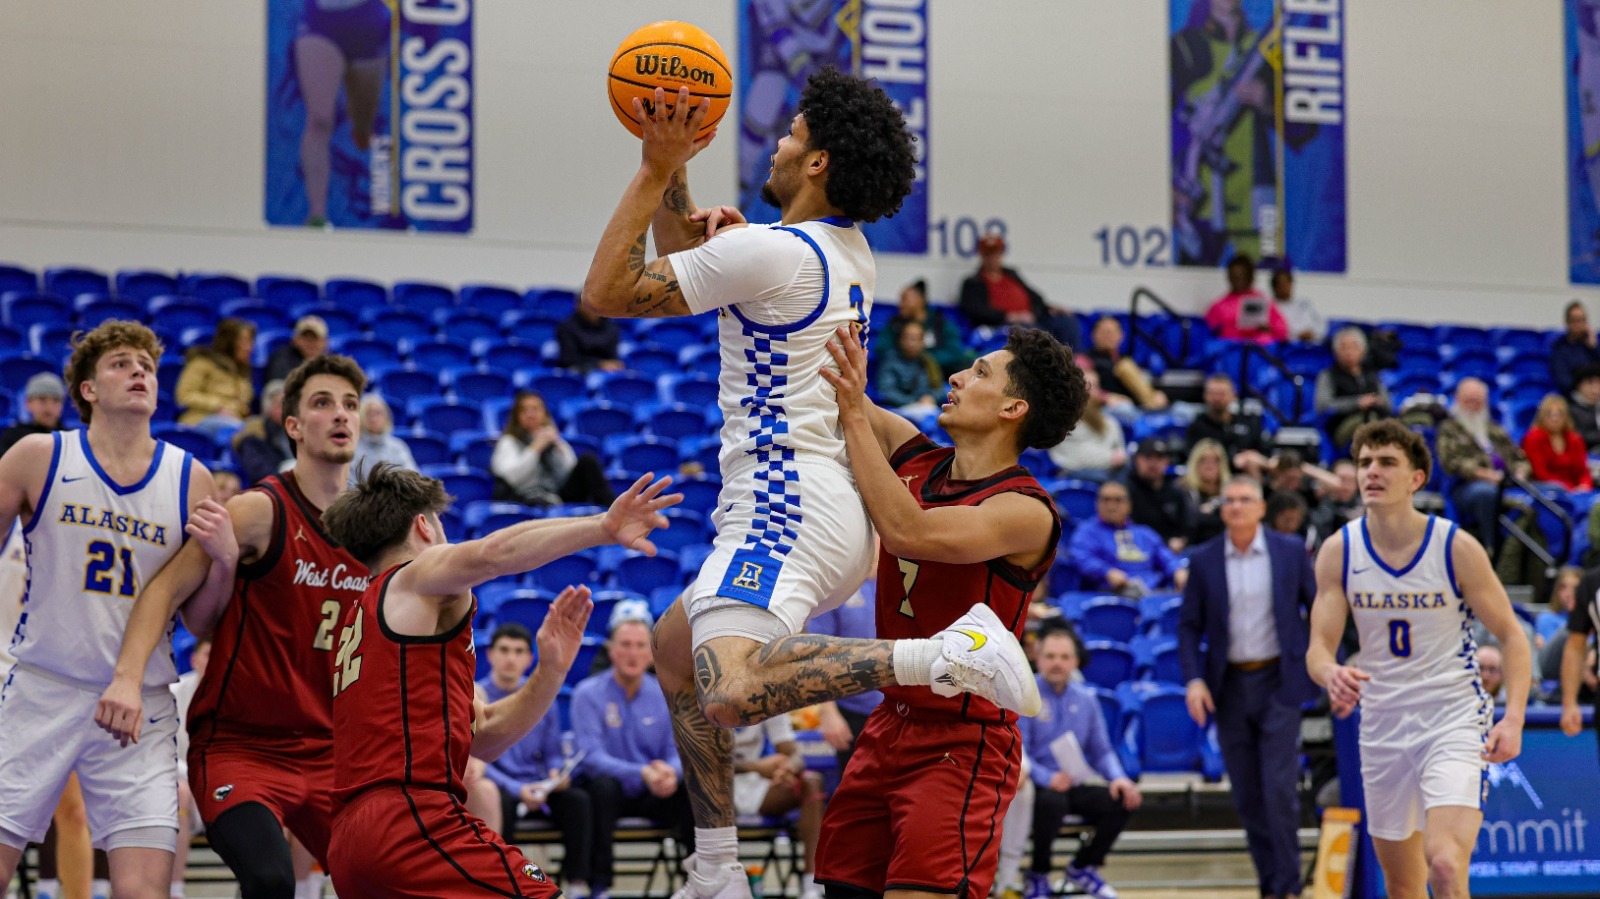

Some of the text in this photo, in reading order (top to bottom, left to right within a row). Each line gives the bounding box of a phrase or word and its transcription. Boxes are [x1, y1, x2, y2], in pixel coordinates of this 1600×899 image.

[862, 0, 925, 84] HO
[635, 53, 716, 87] Wilson
[402, 36, 470, 221] CROSS
[1094, 225, 1168, 267] 102
[58, 502, 169, 548] ALASKA
[83, 538, 137, 599] 21
[292, 558, 330, 588] West
[1353, 589, 1449, 610] ALASKA
[1386, 617, 1414, 659] 0
